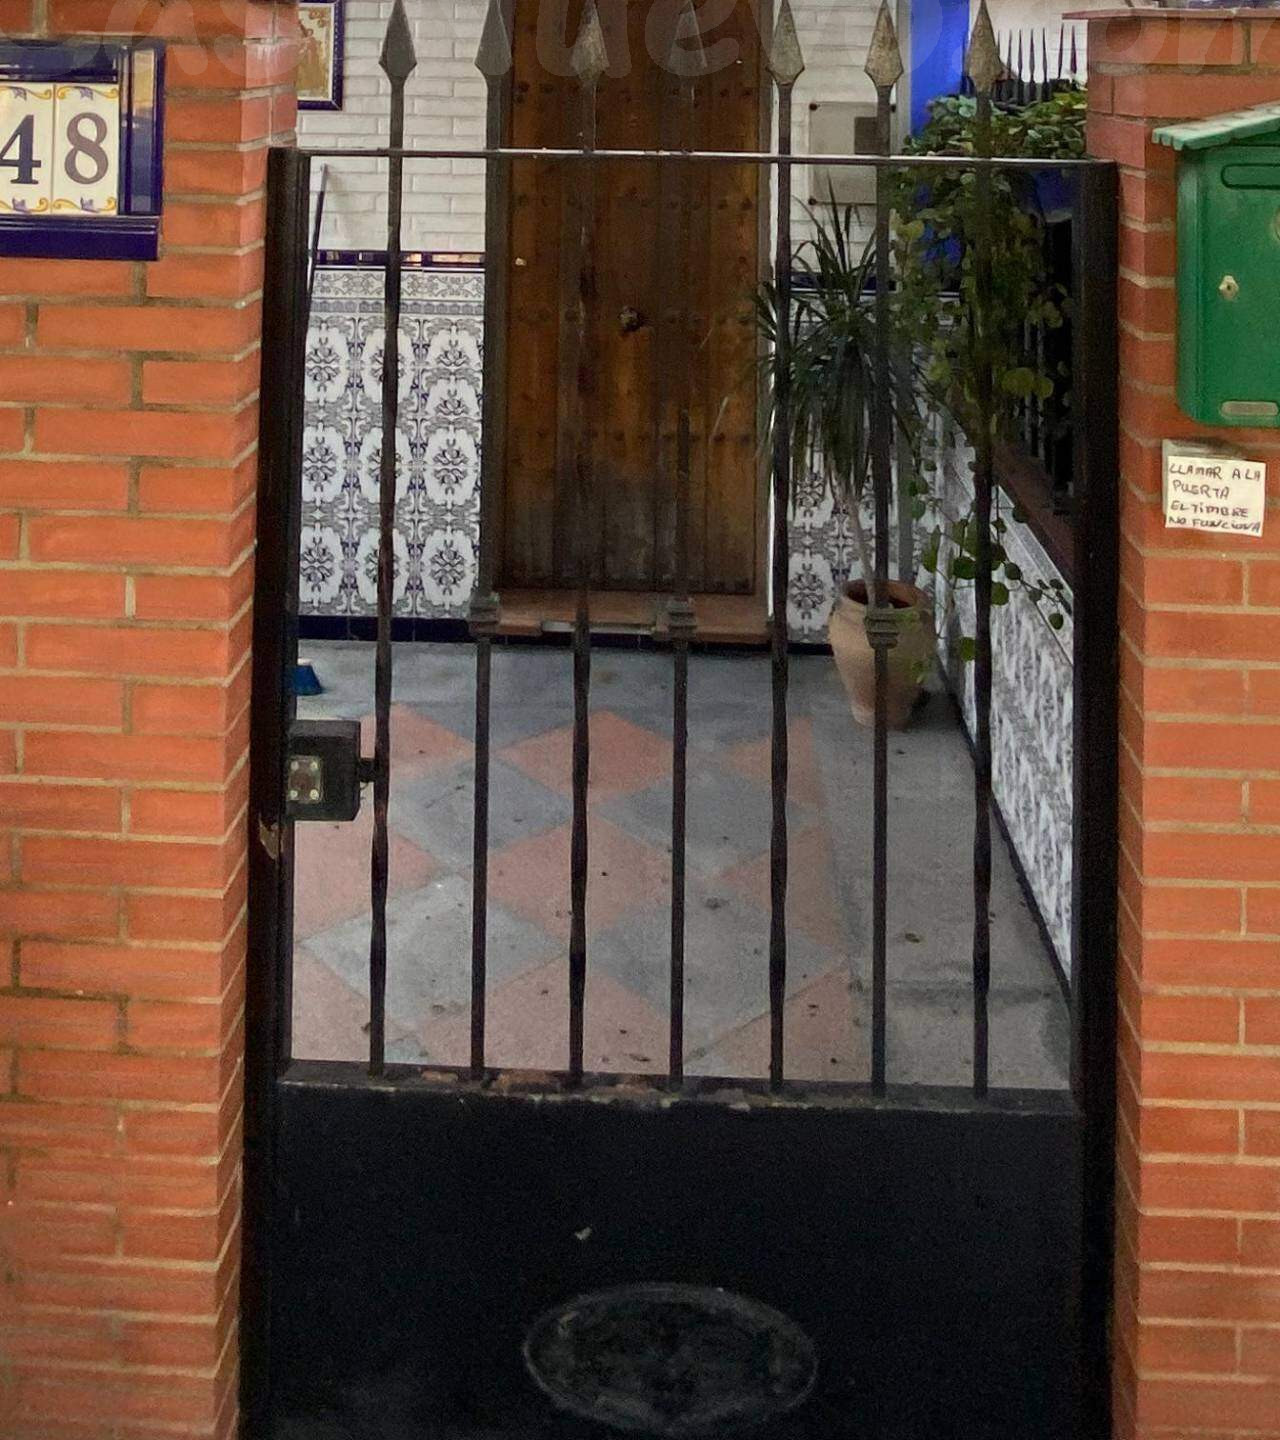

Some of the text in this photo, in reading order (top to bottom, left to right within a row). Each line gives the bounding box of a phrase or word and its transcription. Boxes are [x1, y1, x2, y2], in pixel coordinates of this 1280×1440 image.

[1169, 463, 1261, 482] LLAMAR A LA
[1172, 479, 1230, 500] PUERTA
[1170, 500, 1189, 511] EL
